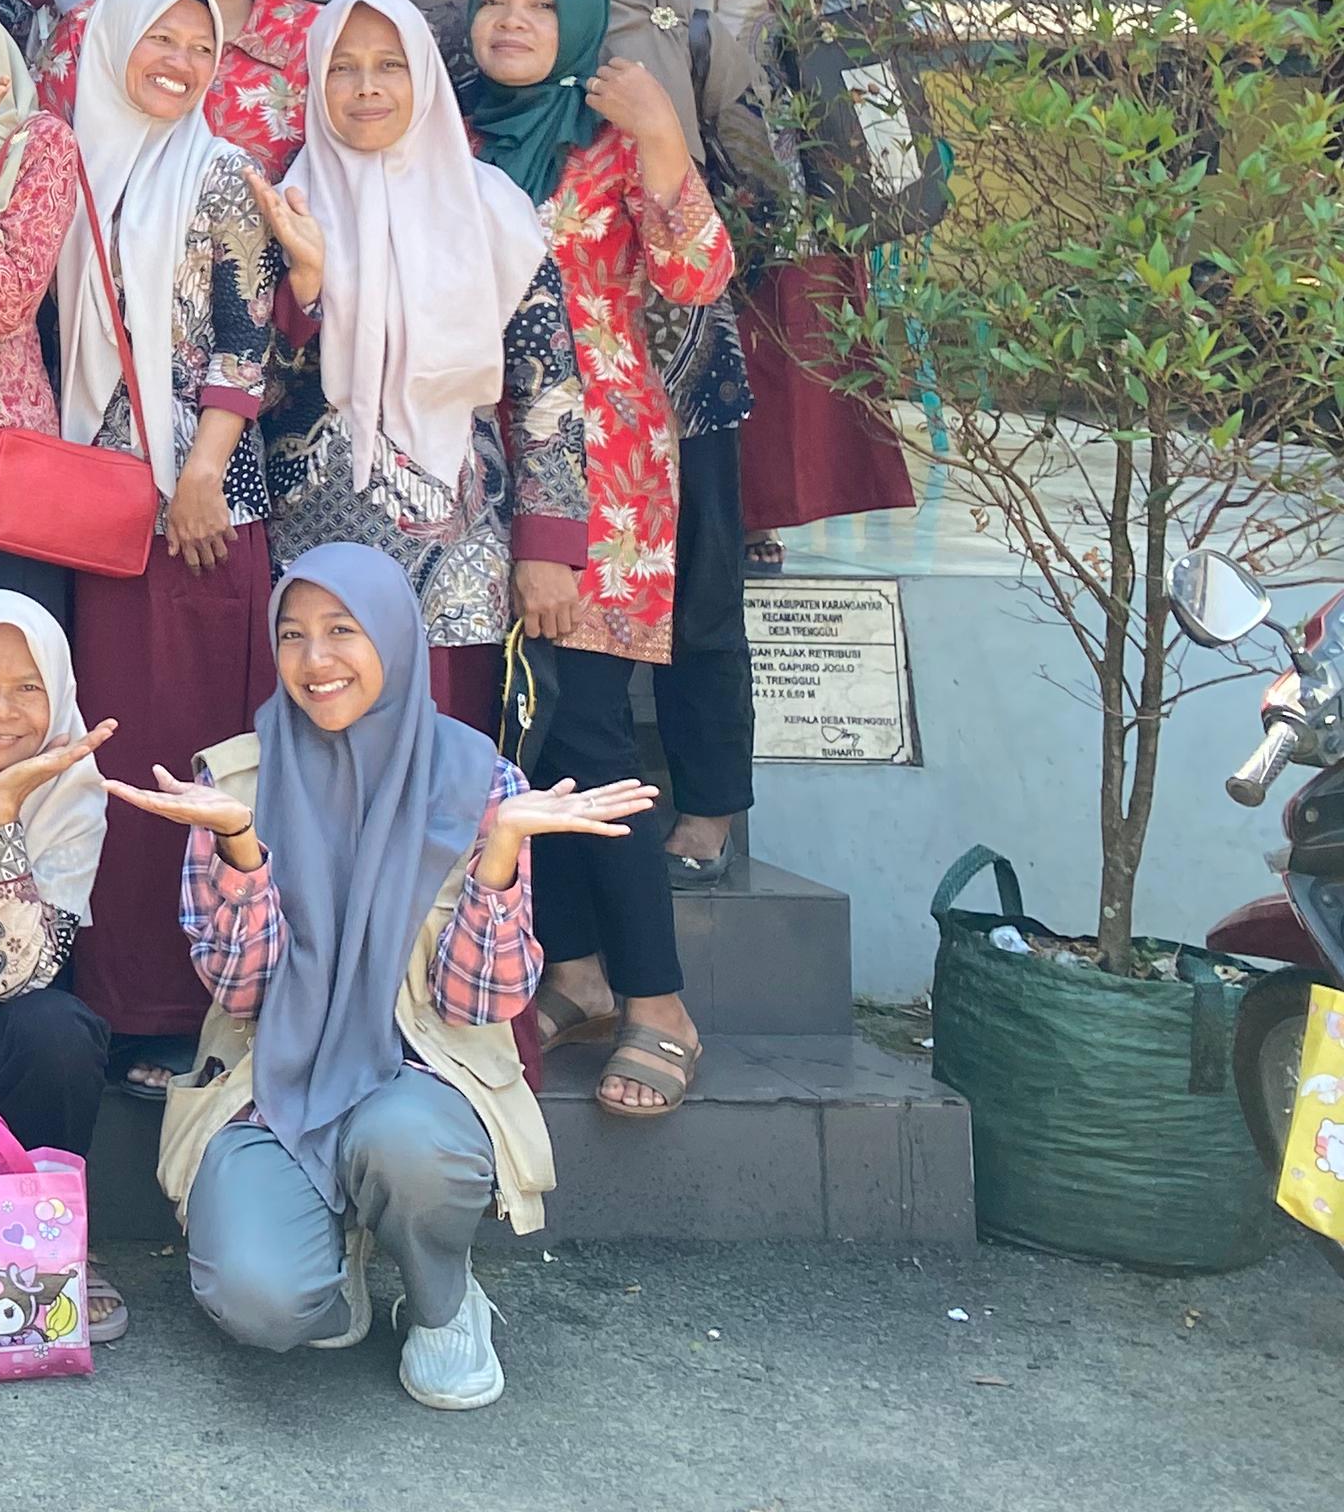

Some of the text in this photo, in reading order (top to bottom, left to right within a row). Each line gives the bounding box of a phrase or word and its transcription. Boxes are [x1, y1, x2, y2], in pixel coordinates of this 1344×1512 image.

[773, 599, 820, 609] KABUPATEN
[822, 600, 882, 611] KARANGANYAR
[762, 613, 811, 623] KECAMATAN
[792, 626, 838, 637] TRENGGULI
[774, 648, 806, 658] PAJAK
[808, 649, 861, 659] RETRIBUSI
[779, 662, 820, 673] GAPURO
[822, 663, 855, 674] JOGLO
[766, 676, 820, 686] TRENGGULI
[784, 715, 818, 725] KEPALA
[820, 716, 845, 726] DESA
[822, 748, 864, 757] SUHARTO
